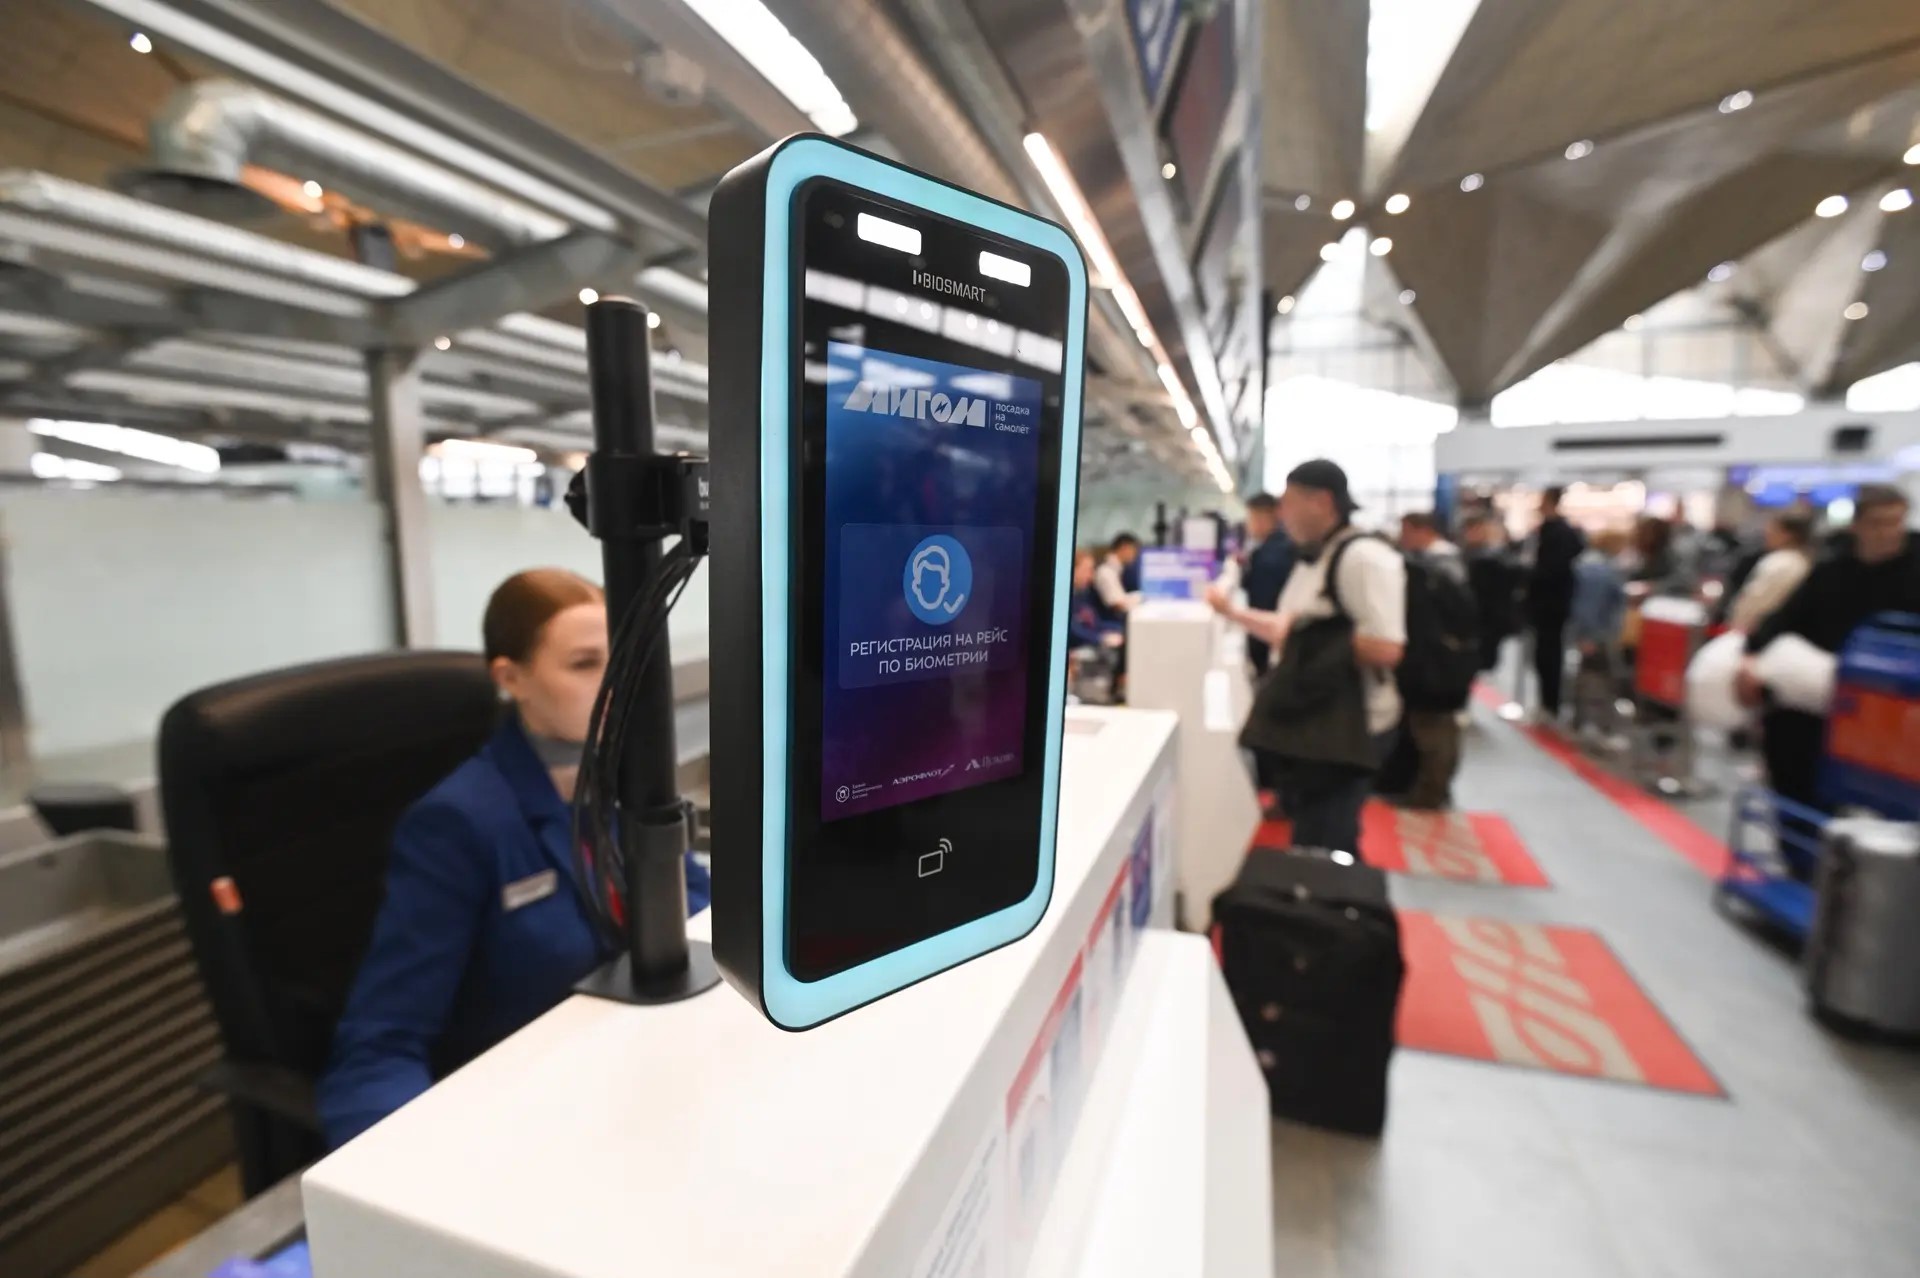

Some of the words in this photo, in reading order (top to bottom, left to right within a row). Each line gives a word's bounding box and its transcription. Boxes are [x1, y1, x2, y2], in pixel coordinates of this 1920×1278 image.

[922, 272, 986, 303] BIOSMART
[843, 380, 986, 427] МИГОМ
[995, 402, 1030, 416] посадка
[995, 413, 1006, 421] на
[995, 421, 1030, 434] самолёт
[850, 635, 951, 657] РЕГИСТРАЦИЯ
[955, 632, 973, 647] НА
[976, 627, 1008, 645] РЕЙС
[878, 659, 900, 674] ПО
[905, 650, 988, 671] БИОМЕТРИИ
